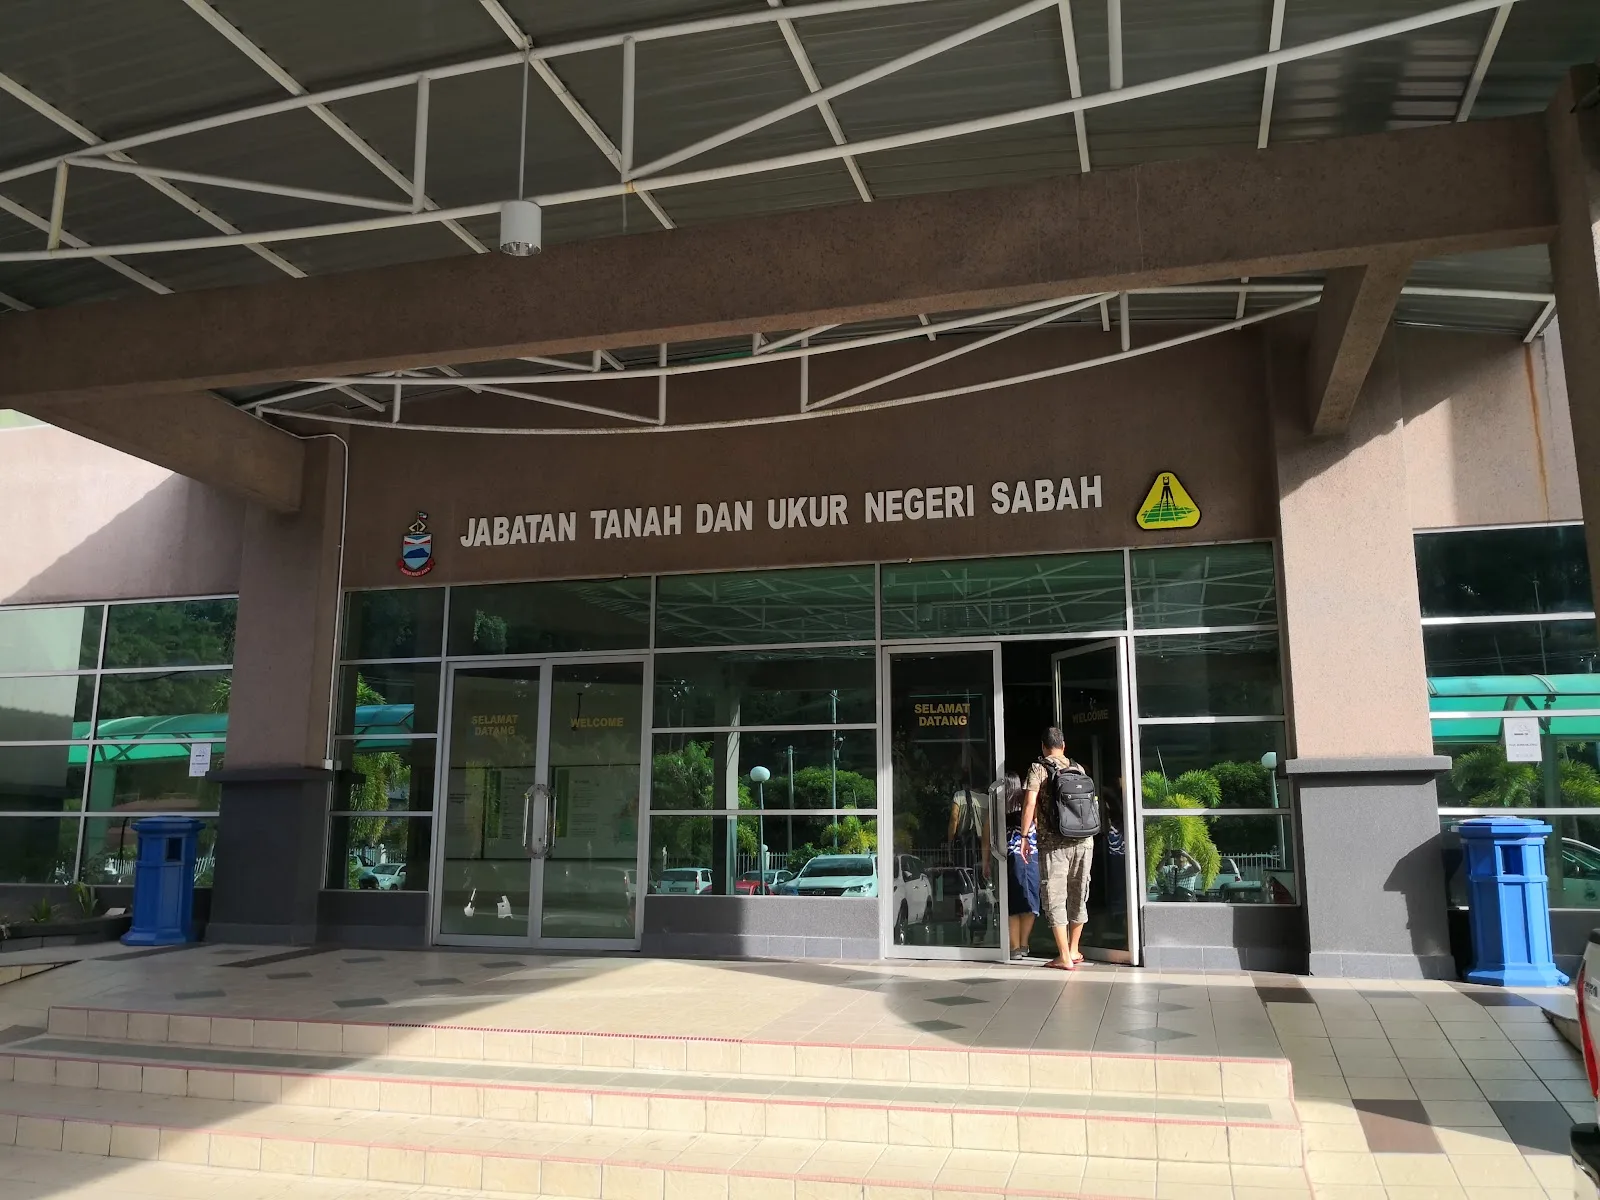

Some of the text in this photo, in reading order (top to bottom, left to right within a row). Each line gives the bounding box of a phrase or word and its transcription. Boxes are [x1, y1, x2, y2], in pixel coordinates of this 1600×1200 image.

[460, 475, 1103, 548] JABATAN TANAH DAN UKUR NEGERI SABAH
[914, 703, 971, 714] SELAMAT
[471, 714, 519, 725] SELAMAT
[918, 715, 968, 727] DATANG
[1071, 708, 1109, 724] WELCOME
[570, 717, 625, 728] WELCOME
[474, 725, 516, 736] DATANG
